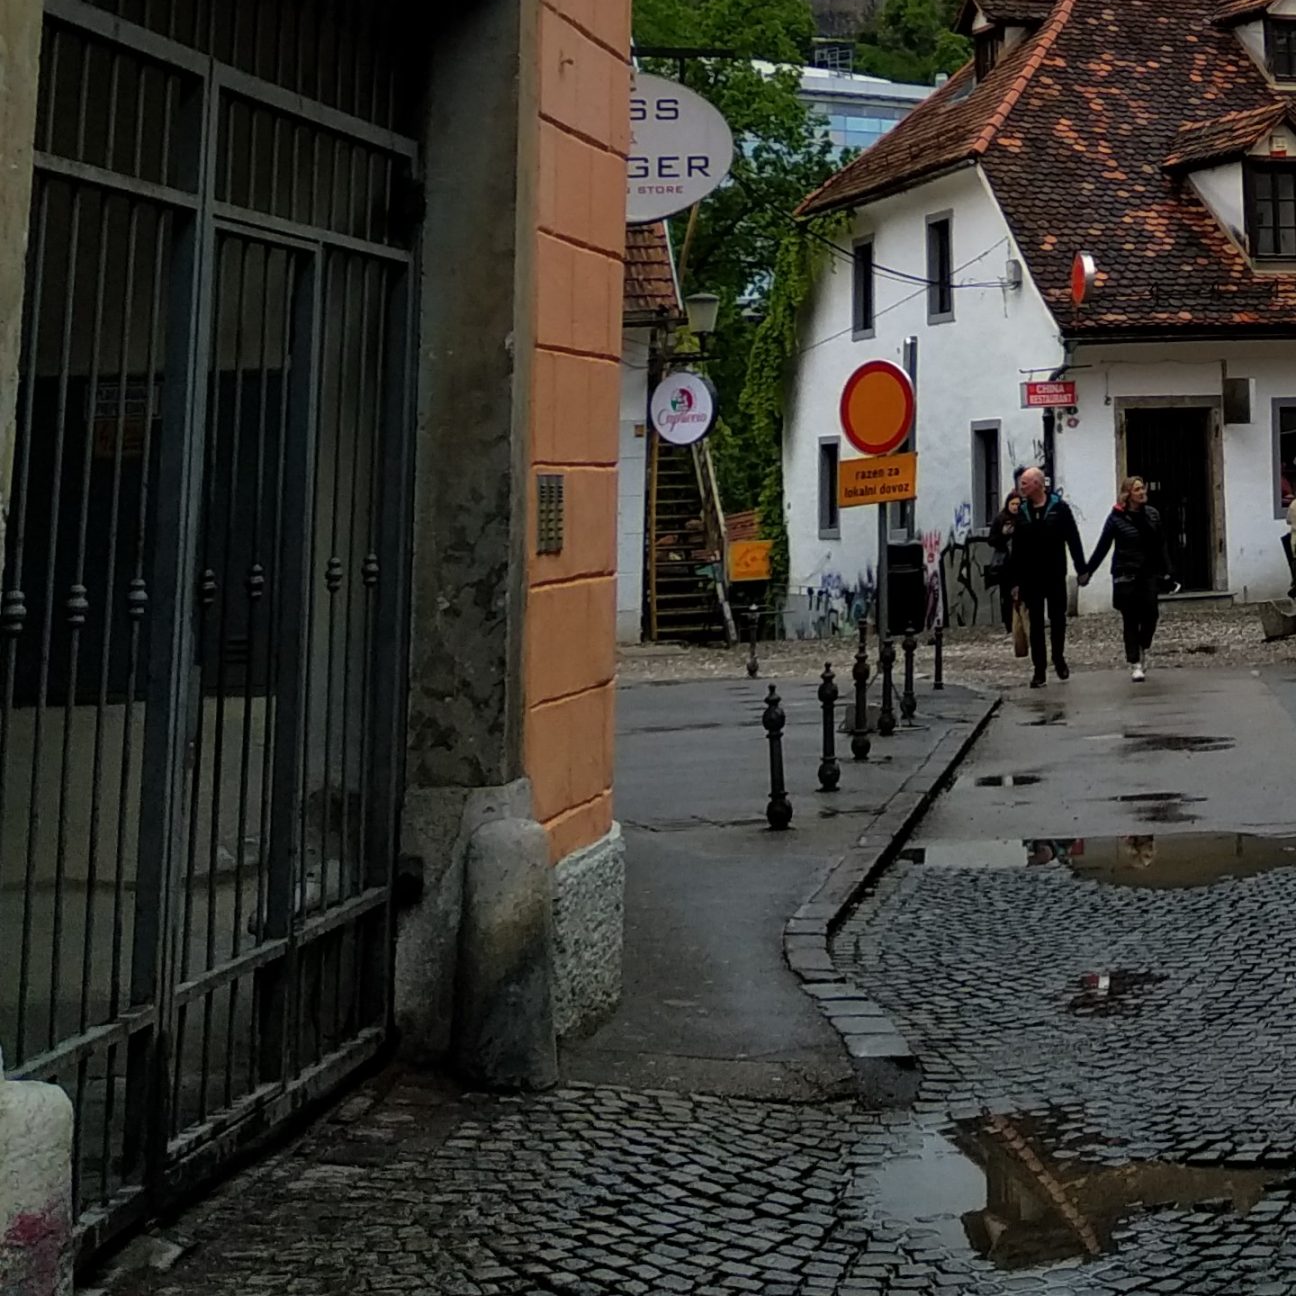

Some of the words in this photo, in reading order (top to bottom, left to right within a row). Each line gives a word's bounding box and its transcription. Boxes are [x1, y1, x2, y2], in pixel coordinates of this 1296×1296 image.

[638, 186, 683, 194] STORE
[1036, 384, 1065, 394] CHINA
[855, 468, 884, 480] razen
[888, 467, 900, 477] za
[844, 485, 877, 498] lokalni
[880, 483, 909, 495] dovoz
